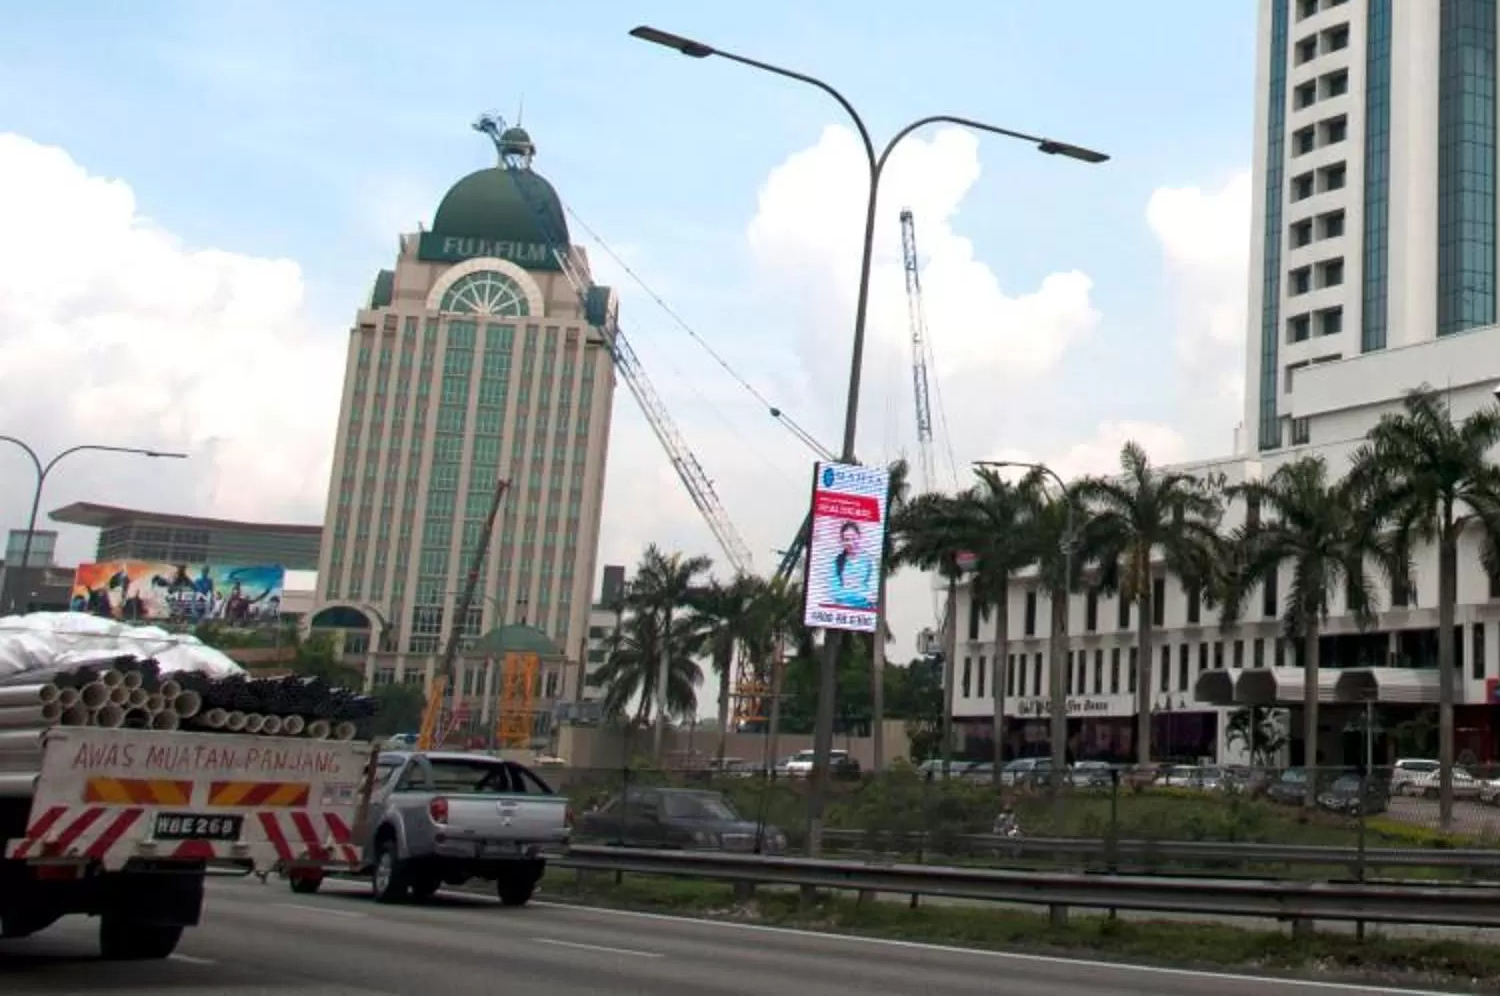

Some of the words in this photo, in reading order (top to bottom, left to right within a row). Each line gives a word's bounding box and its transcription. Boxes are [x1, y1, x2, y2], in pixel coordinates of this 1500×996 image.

[71, 742, 137, 769] AWAS
[144, 742, 235, 771] MUATAN
[244, 747, 341, 773] PANJANG
